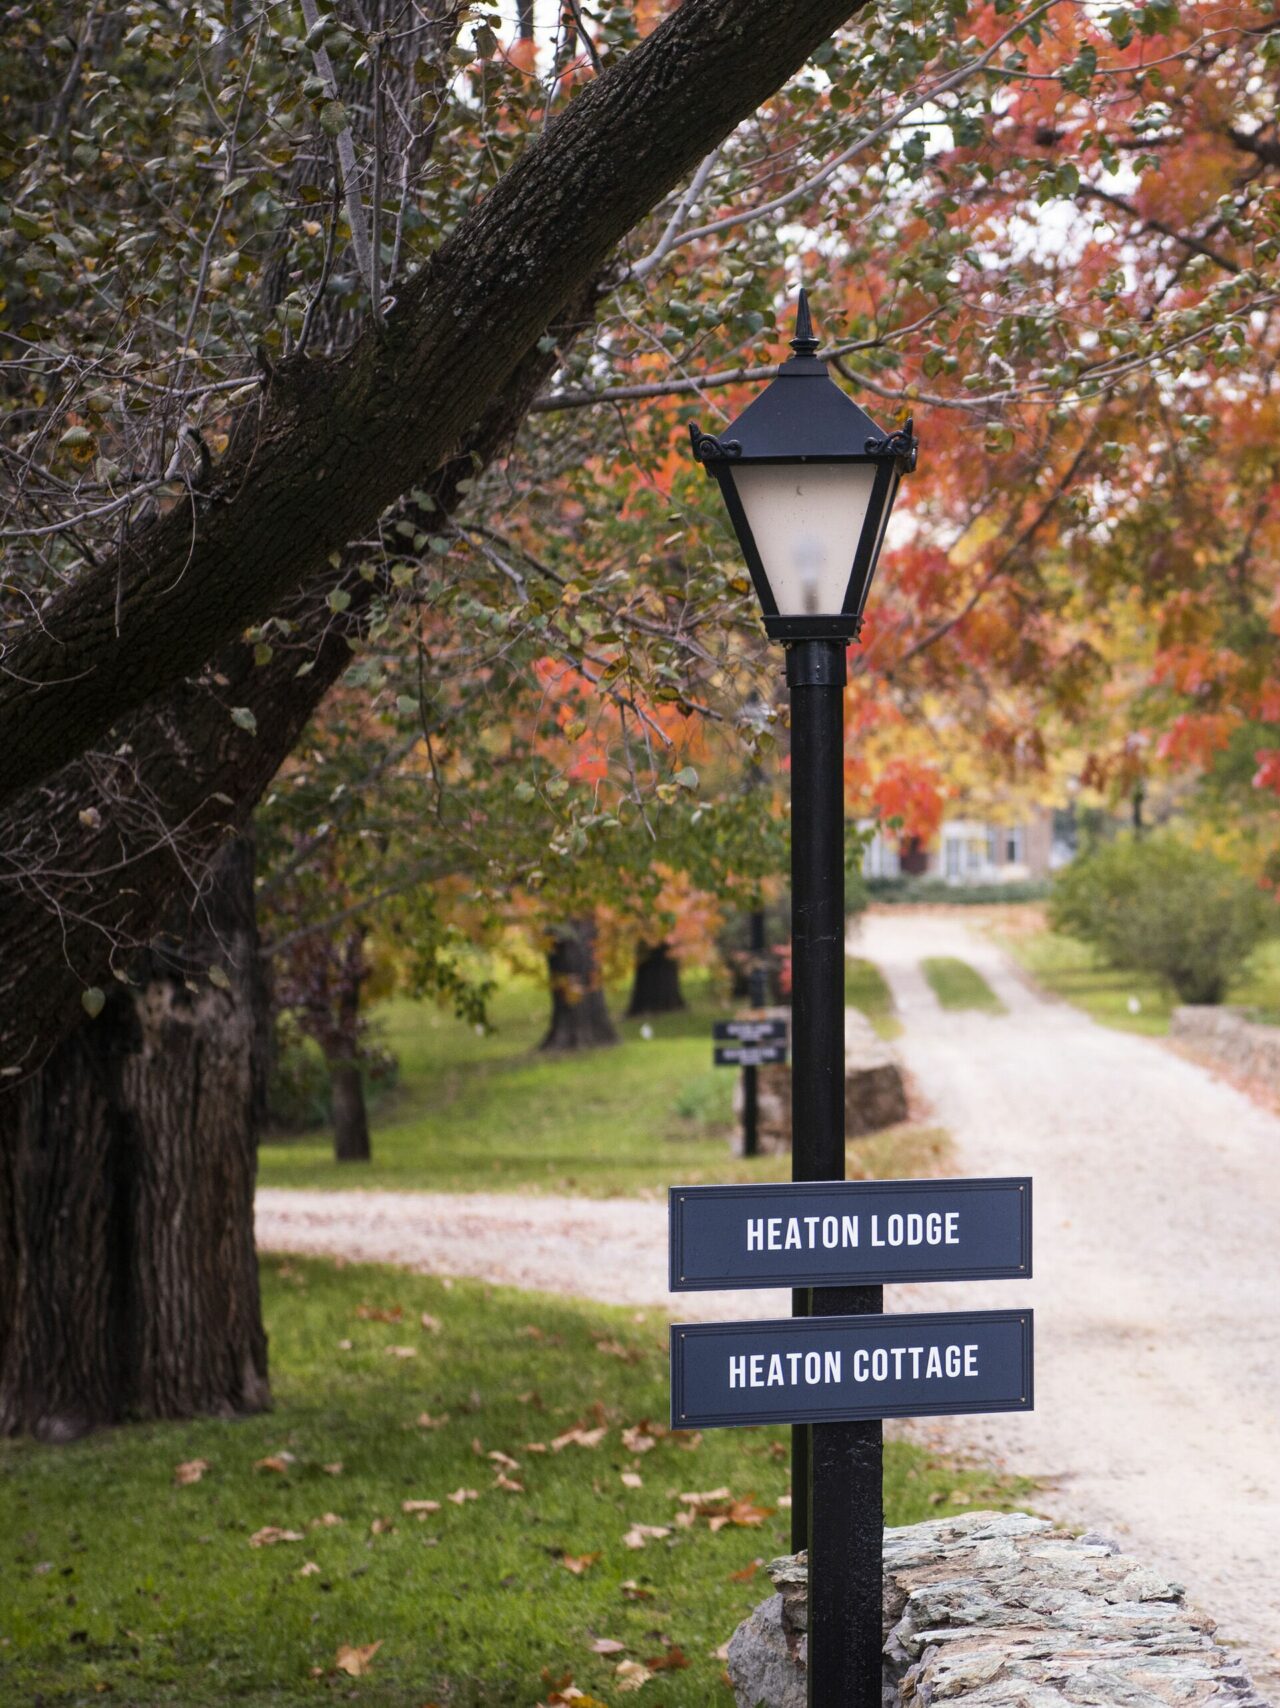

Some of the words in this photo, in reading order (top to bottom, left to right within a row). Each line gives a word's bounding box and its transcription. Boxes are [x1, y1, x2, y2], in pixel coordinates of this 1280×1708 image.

[747, 1215, 859, 1251] HEATON
[871, 1212, 960, 1247] LODGE
[729, 1350, 842, 1388] HEATON
[853, 1344, 979, 1383] COTTAGE
